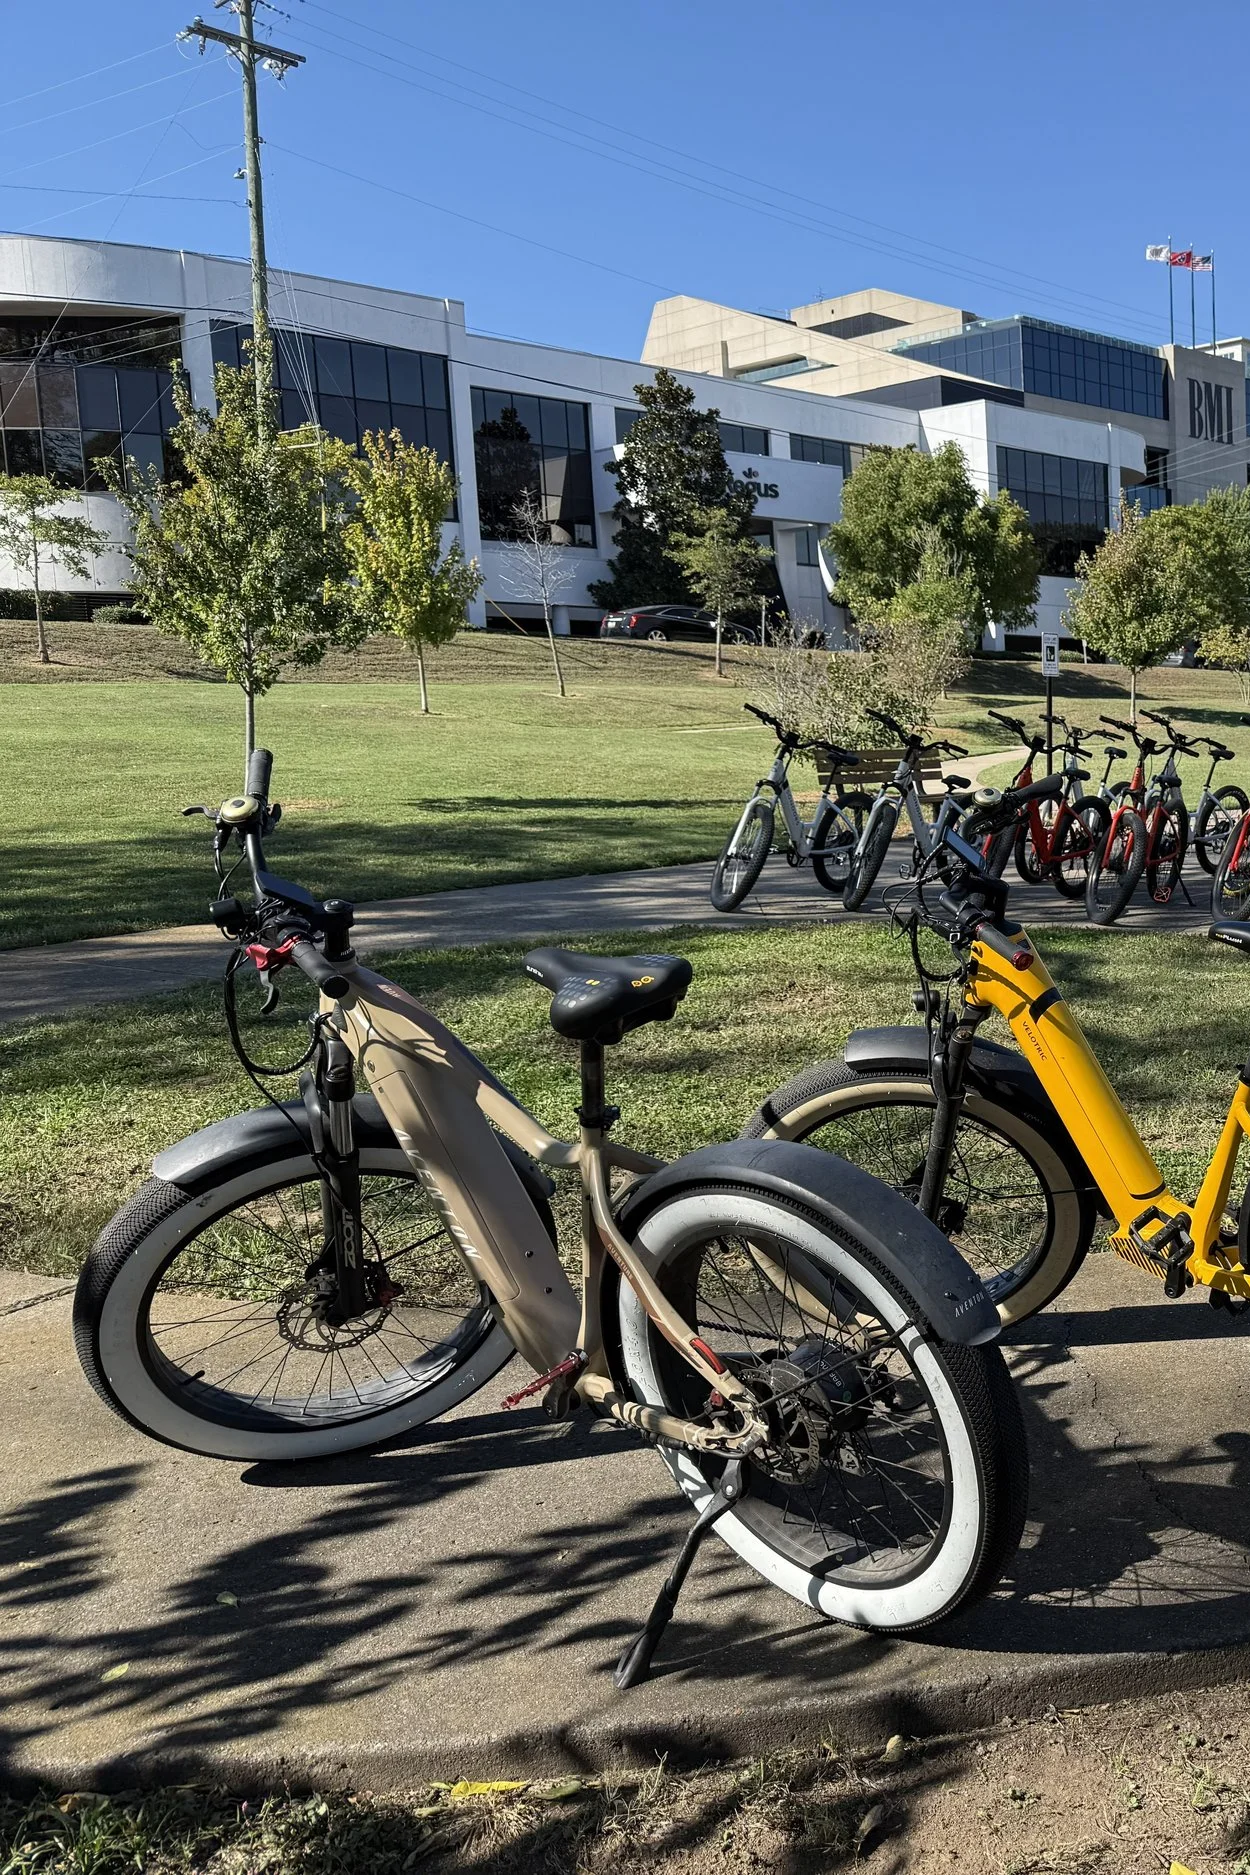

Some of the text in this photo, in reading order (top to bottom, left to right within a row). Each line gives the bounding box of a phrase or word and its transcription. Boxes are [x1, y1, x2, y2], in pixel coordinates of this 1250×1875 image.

[1186, 377, 1235, 446] BMI
[1022, 1021, 1048, 1062] VELOTRIC
[393, 1128, 482, 1260] AVENTON
[607, 1243, 634, 1280] AVENTURE
[955, 1291, 985, 1318] AVENTON
